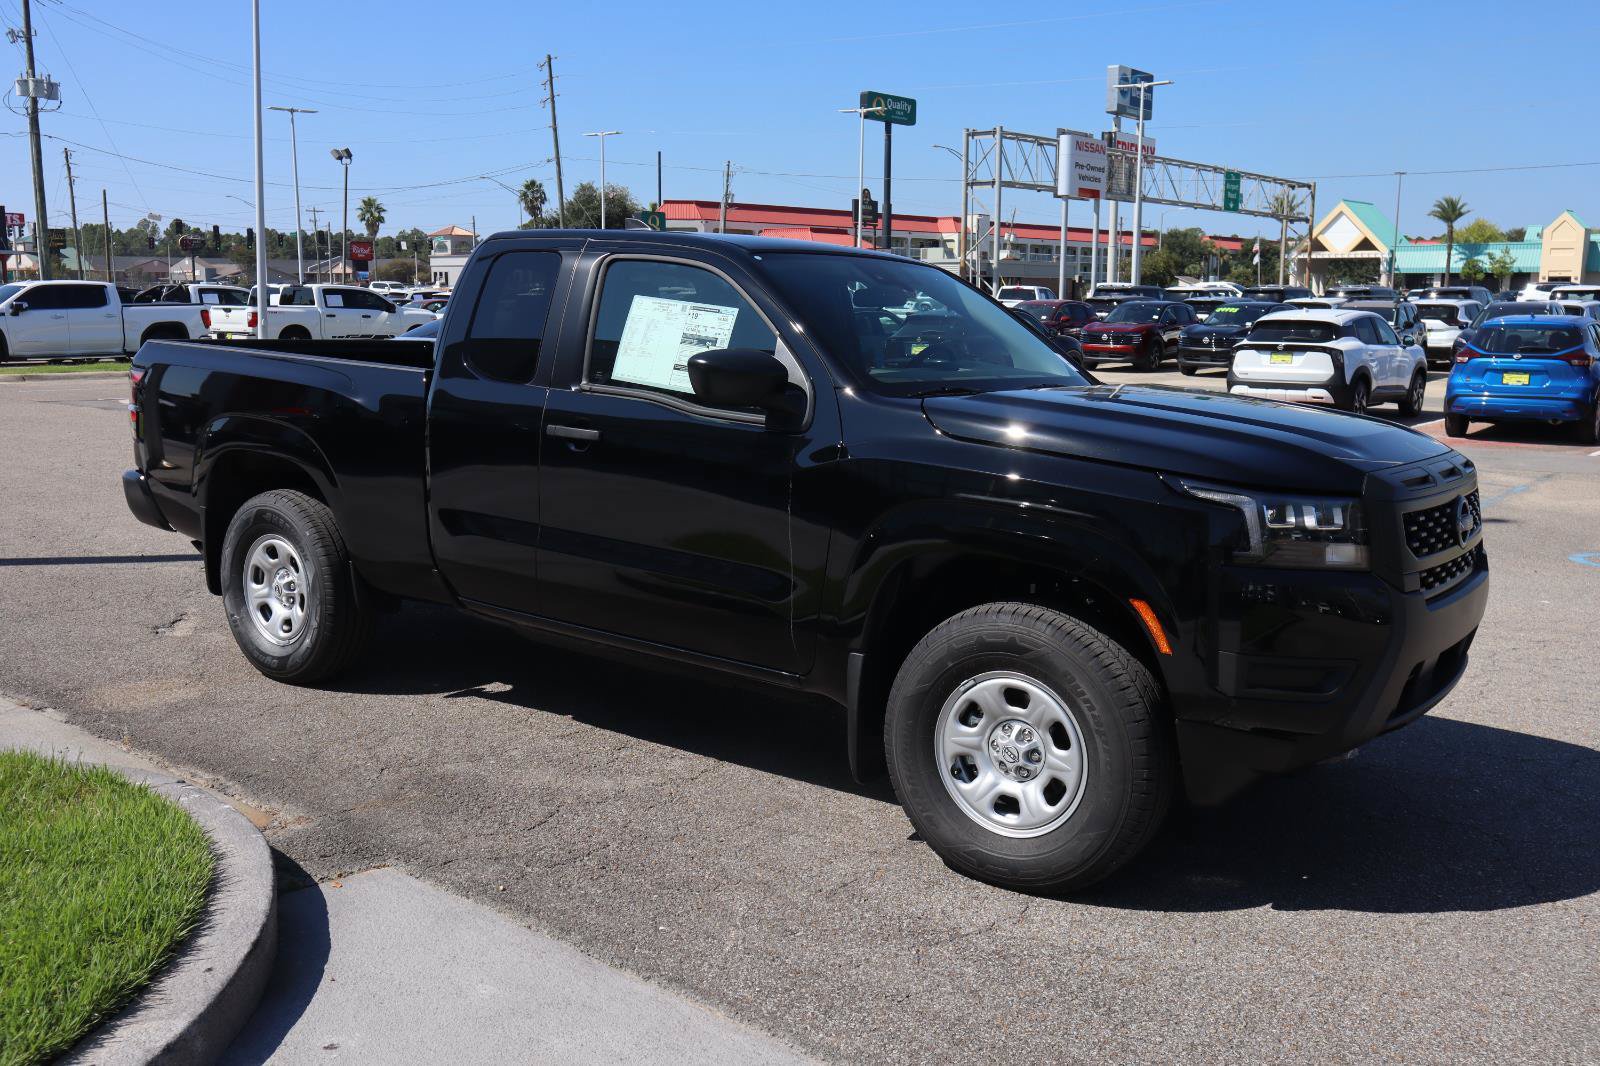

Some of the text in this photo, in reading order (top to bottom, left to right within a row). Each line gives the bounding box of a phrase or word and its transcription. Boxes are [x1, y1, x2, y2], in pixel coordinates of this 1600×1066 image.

[886, 98, 912, 114] Quality
[1075, 140, 1106, 155] NISSAN
[1074, 161, 1105, 174] Pre-Owned
[1078, 173, 1102, 184] Vehicles
